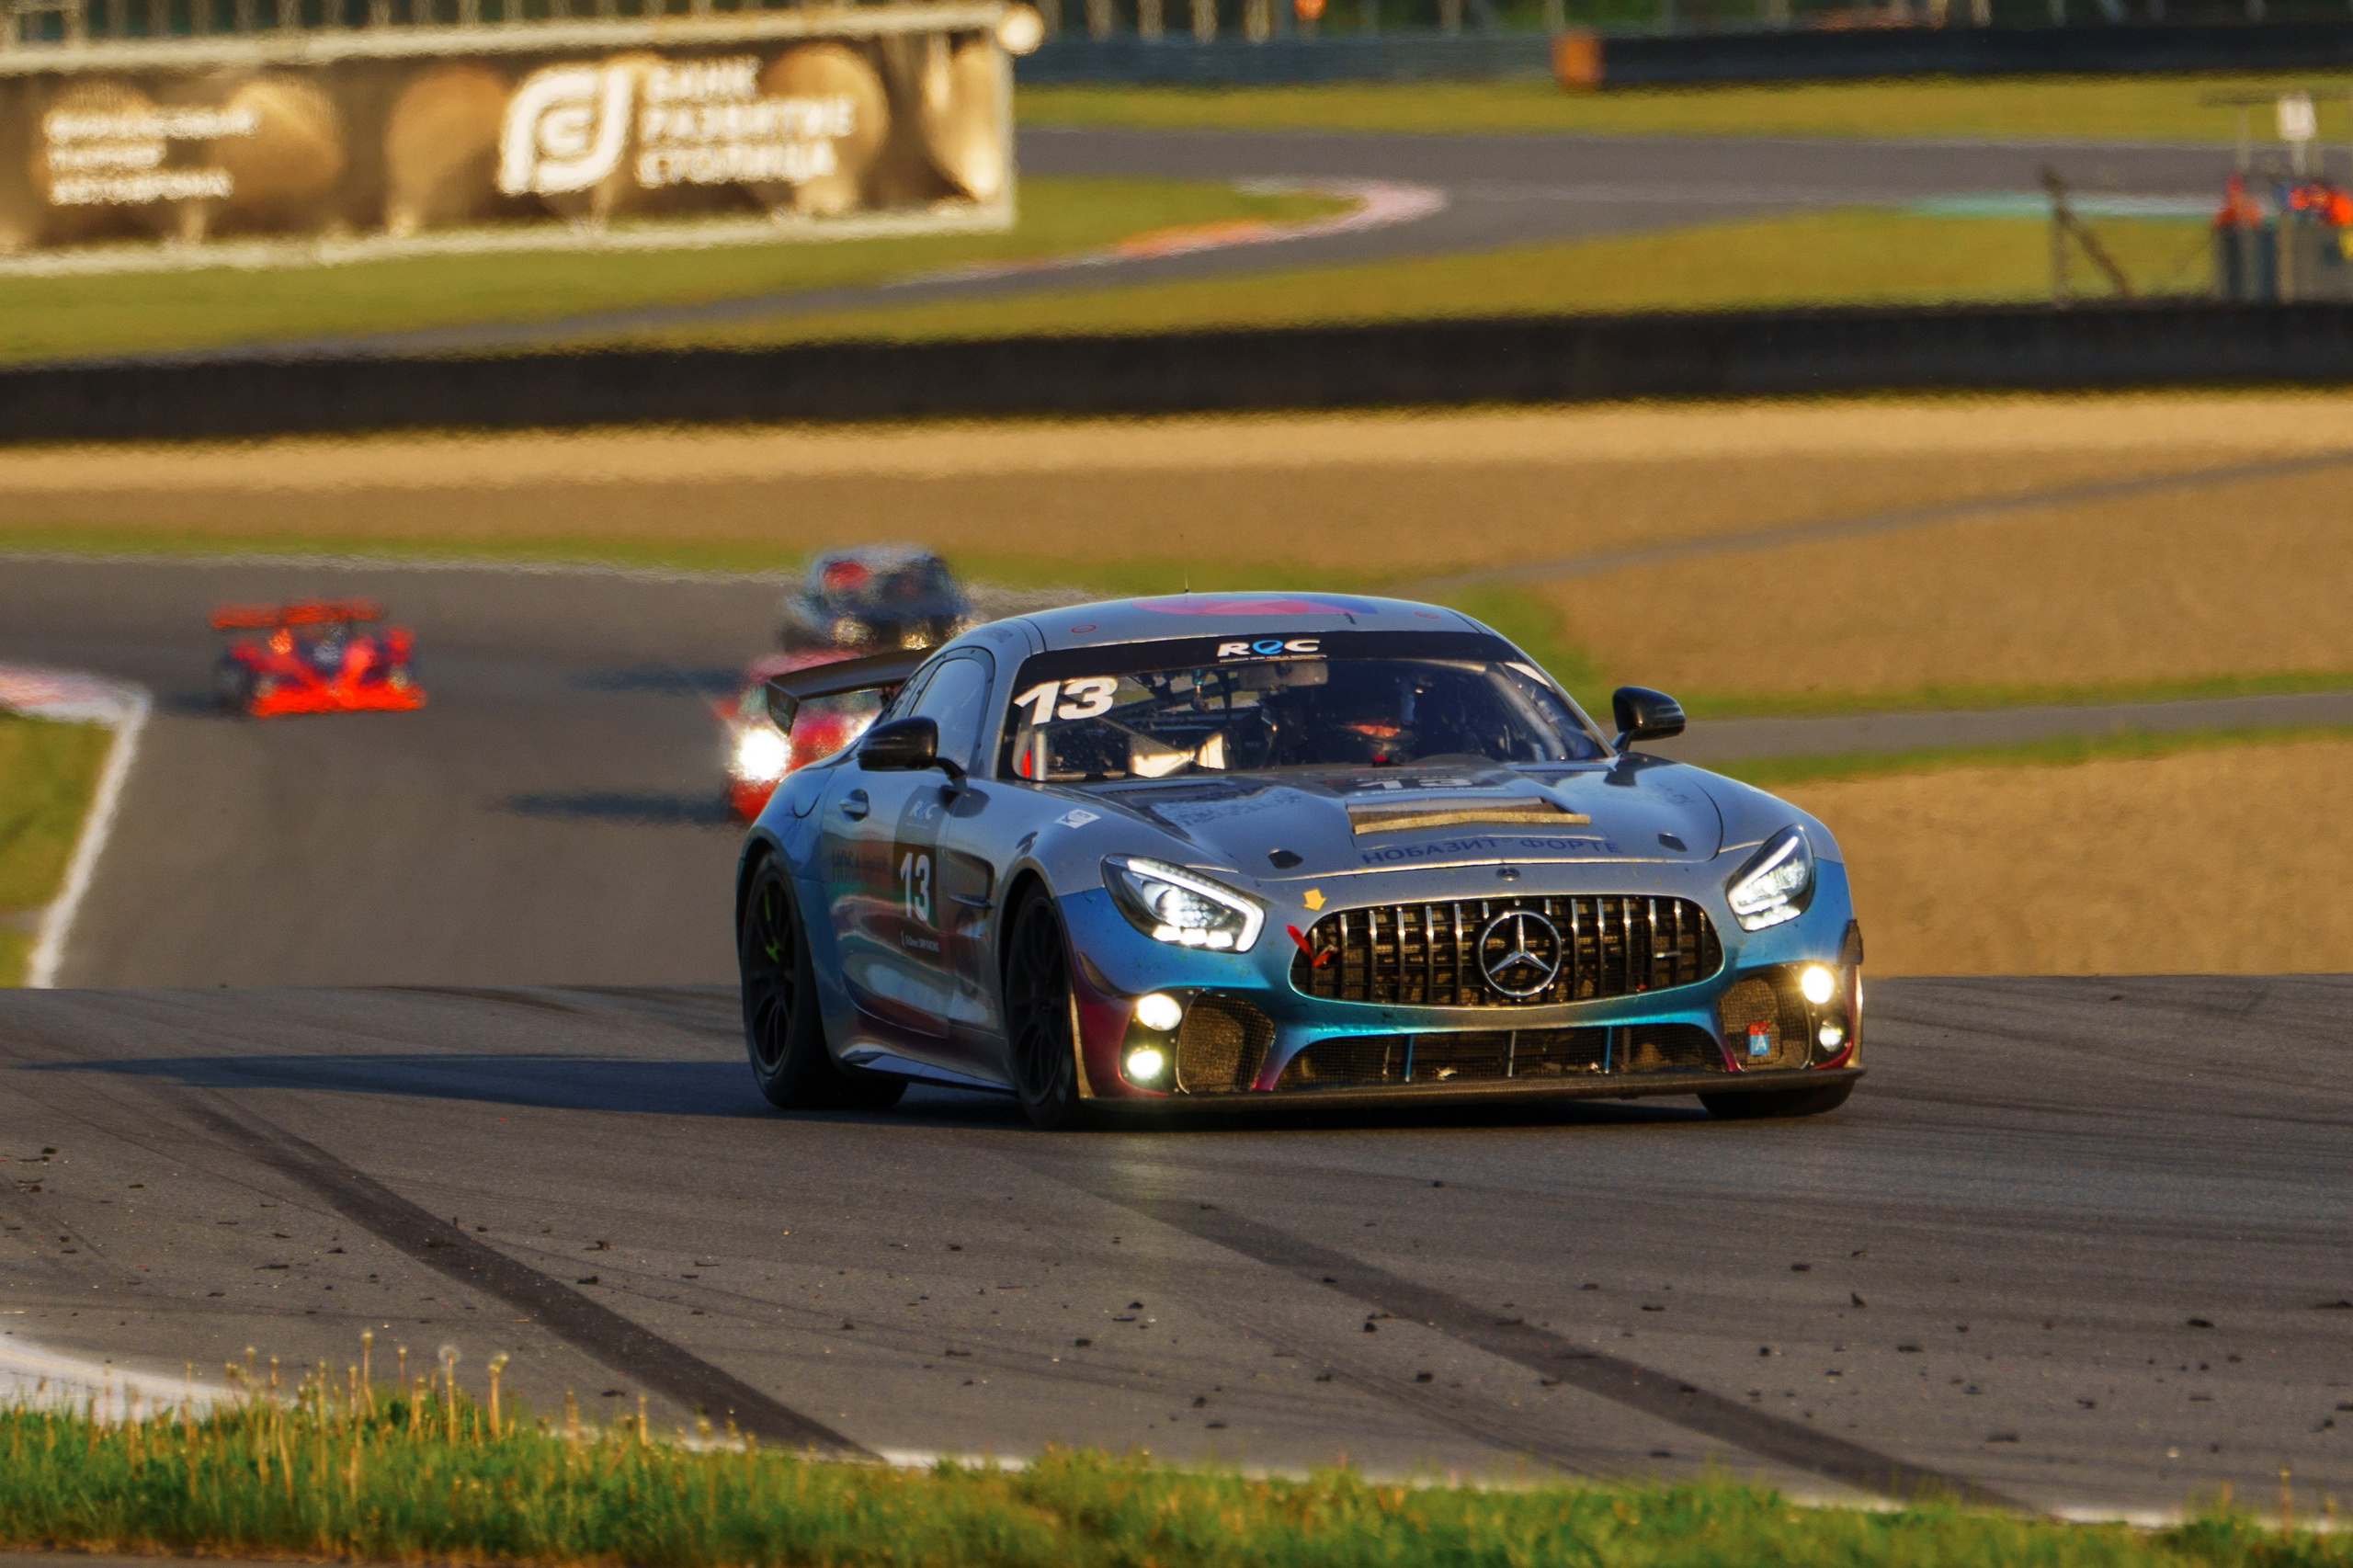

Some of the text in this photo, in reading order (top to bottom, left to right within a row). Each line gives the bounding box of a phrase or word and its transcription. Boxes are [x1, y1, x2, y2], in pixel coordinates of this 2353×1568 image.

[1014, 676, 1119, 726] 13
[1361, 837, 1623, 865] НОБАЗИТ ФОРТЕ
[900, 851, 930, 922] 13
